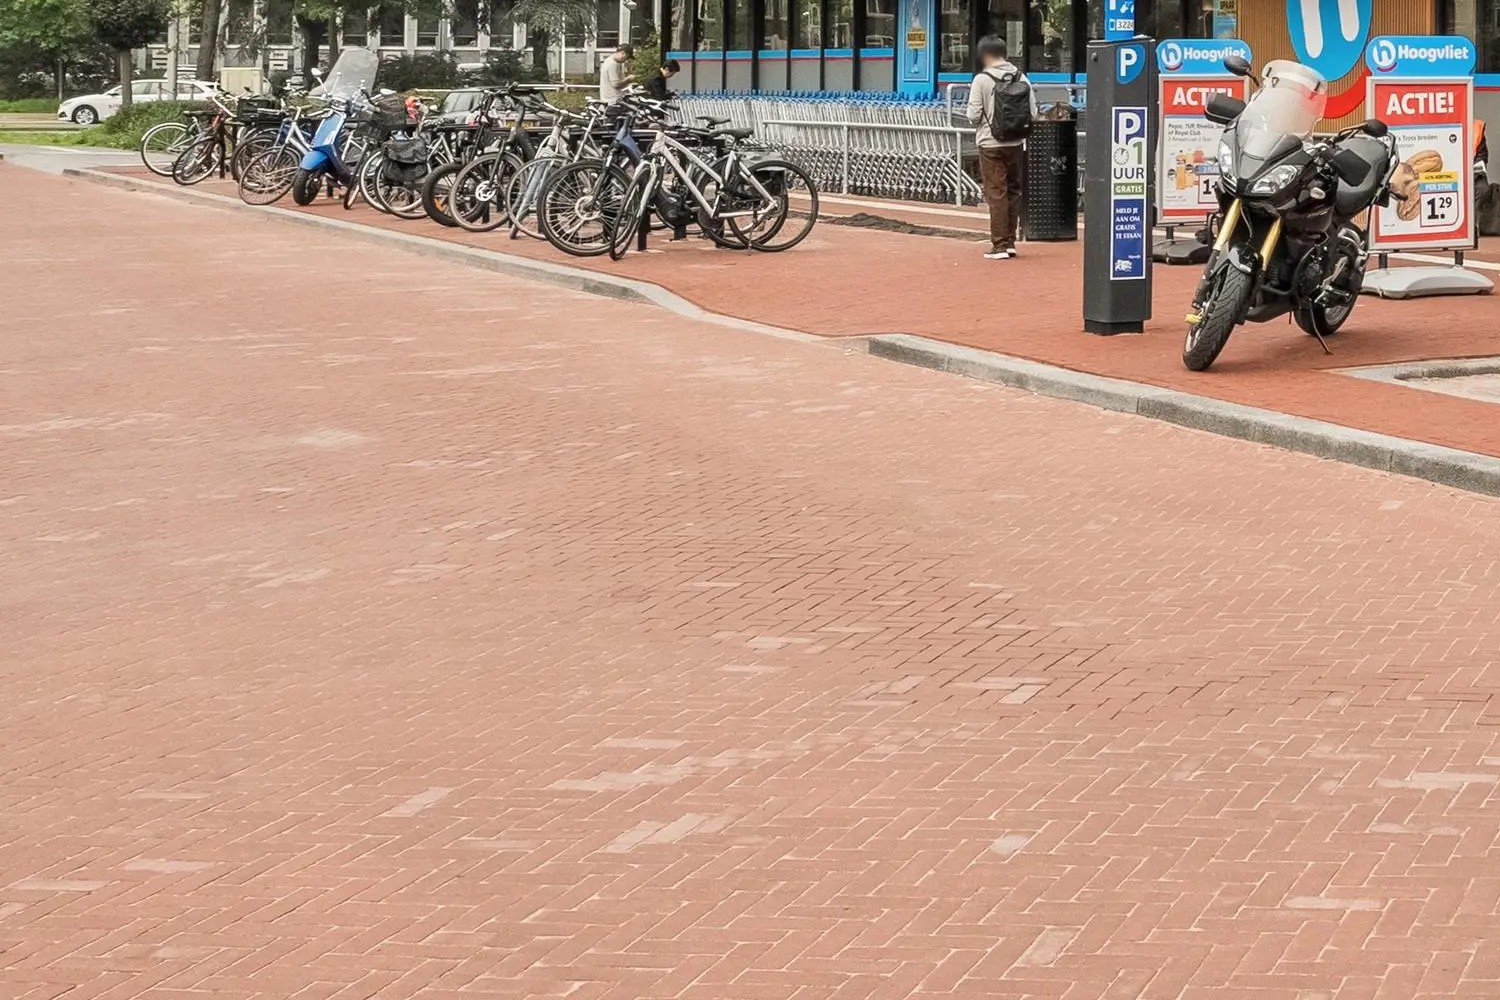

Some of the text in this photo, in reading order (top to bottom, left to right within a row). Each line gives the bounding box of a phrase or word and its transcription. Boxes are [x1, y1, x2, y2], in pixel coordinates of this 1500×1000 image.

[1120, 48, 1138, 77] P
[1397, 44, 1469, 62] Hoogvliet
[1386, 91, 1455, 116] ACTIE!
[1119, 112, 1141, 146] P
[1133, 141, 1143, 165] 1
[1113, 167, 1145, 180] UUR
[1115, 185, 1143, 194] GRATIS
[1427, 196, 1453, 220] 1.29
